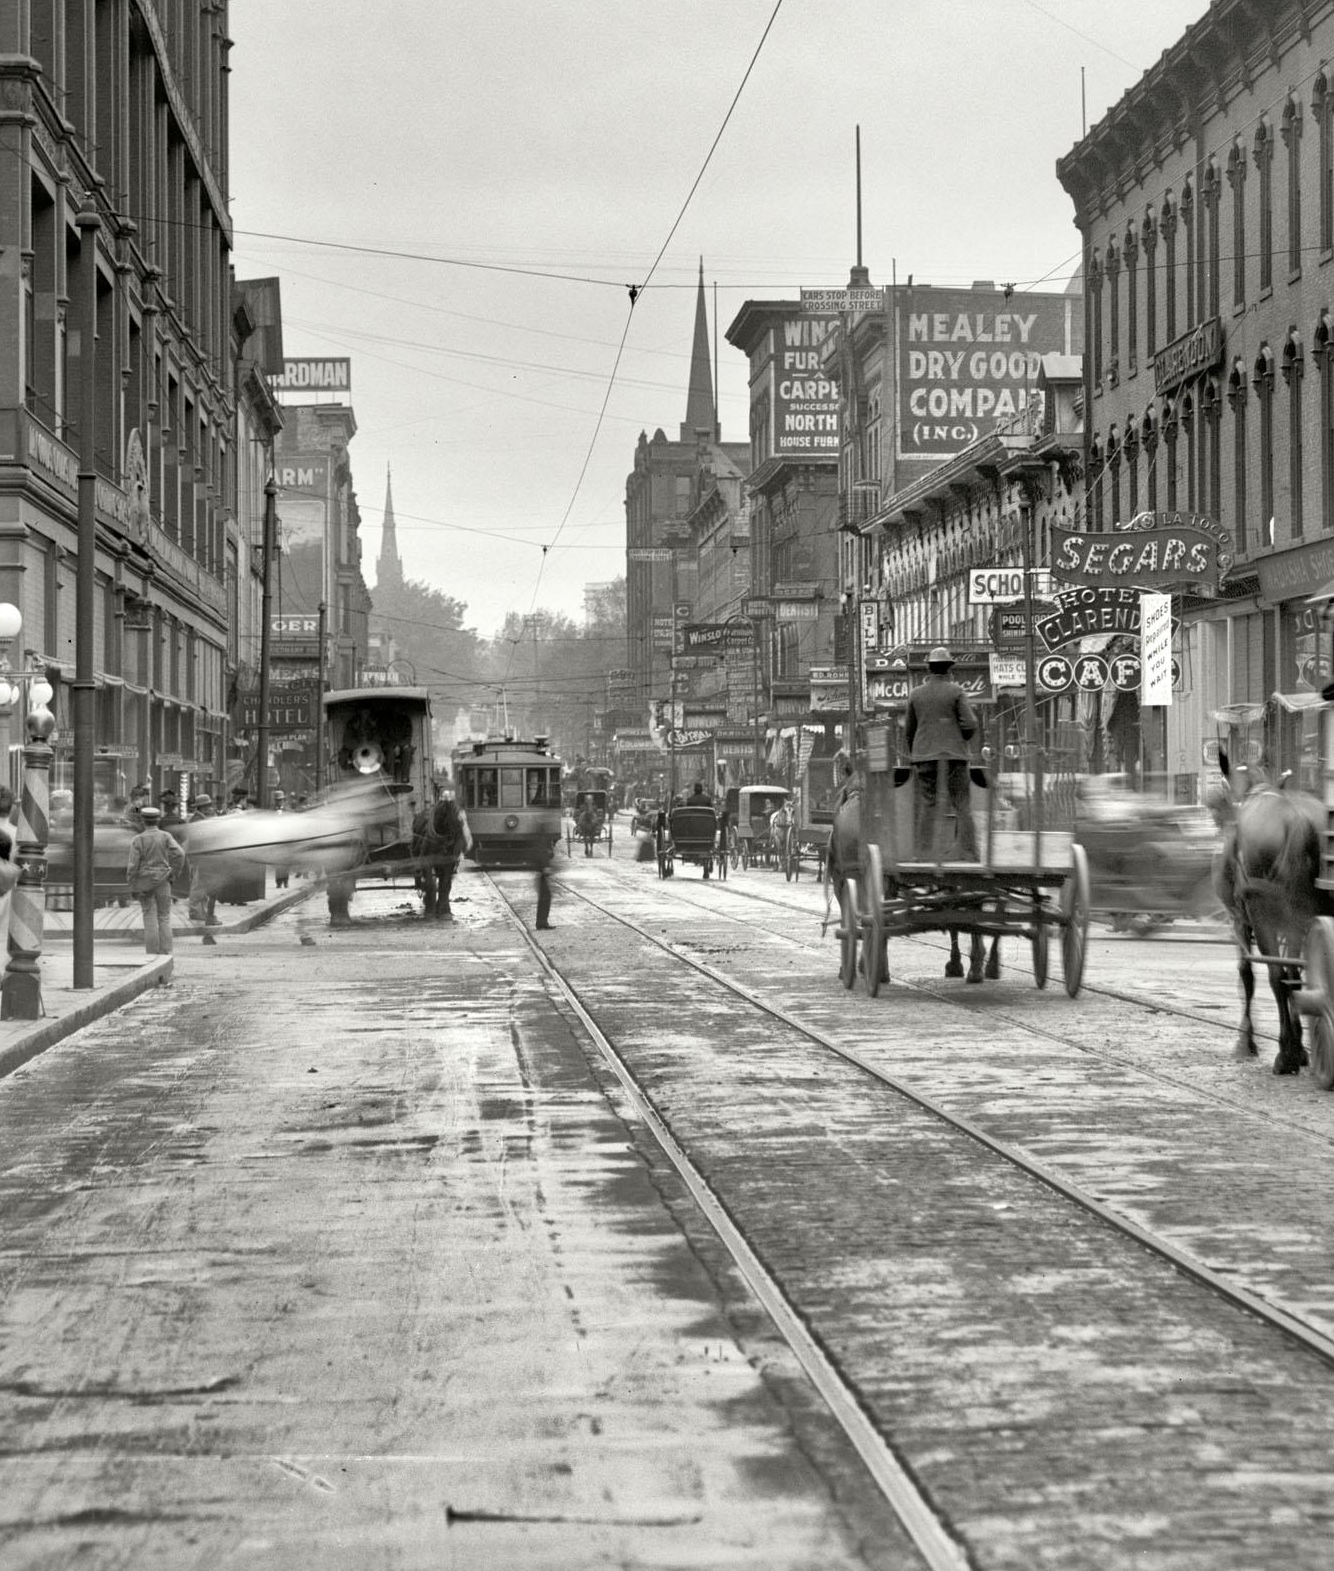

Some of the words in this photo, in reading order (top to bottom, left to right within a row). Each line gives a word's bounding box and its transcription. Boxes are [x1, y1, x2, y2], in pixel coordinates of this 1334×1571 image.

[803, 291, 825, 300] CARS
[827, 290, 848, 300] STOP
[805, 301, 846, 310] CROSSING
[909, 314, 1039, 342] MEALEY
[909, 350, 966, 379] DRY
[969, 350, 1060, 379] GOOD
[785, 415, 838, 431] NORTH
[780, 437, 811, 448] HOUSE
[1162, 513, 1182, 525] LA
[1056, 536, 1211, 575] SEGARS
[974, 574, 1050, 597] SCHOL
[1061, 589, 1142, 608] HOTE
[1003, 615, 1026, 625] POOL
[1044, 608, 1142, 643] CLAREND
[243, 695, 309, 705] CHDLER'S
[245, 709, 308, 724] HTEL
